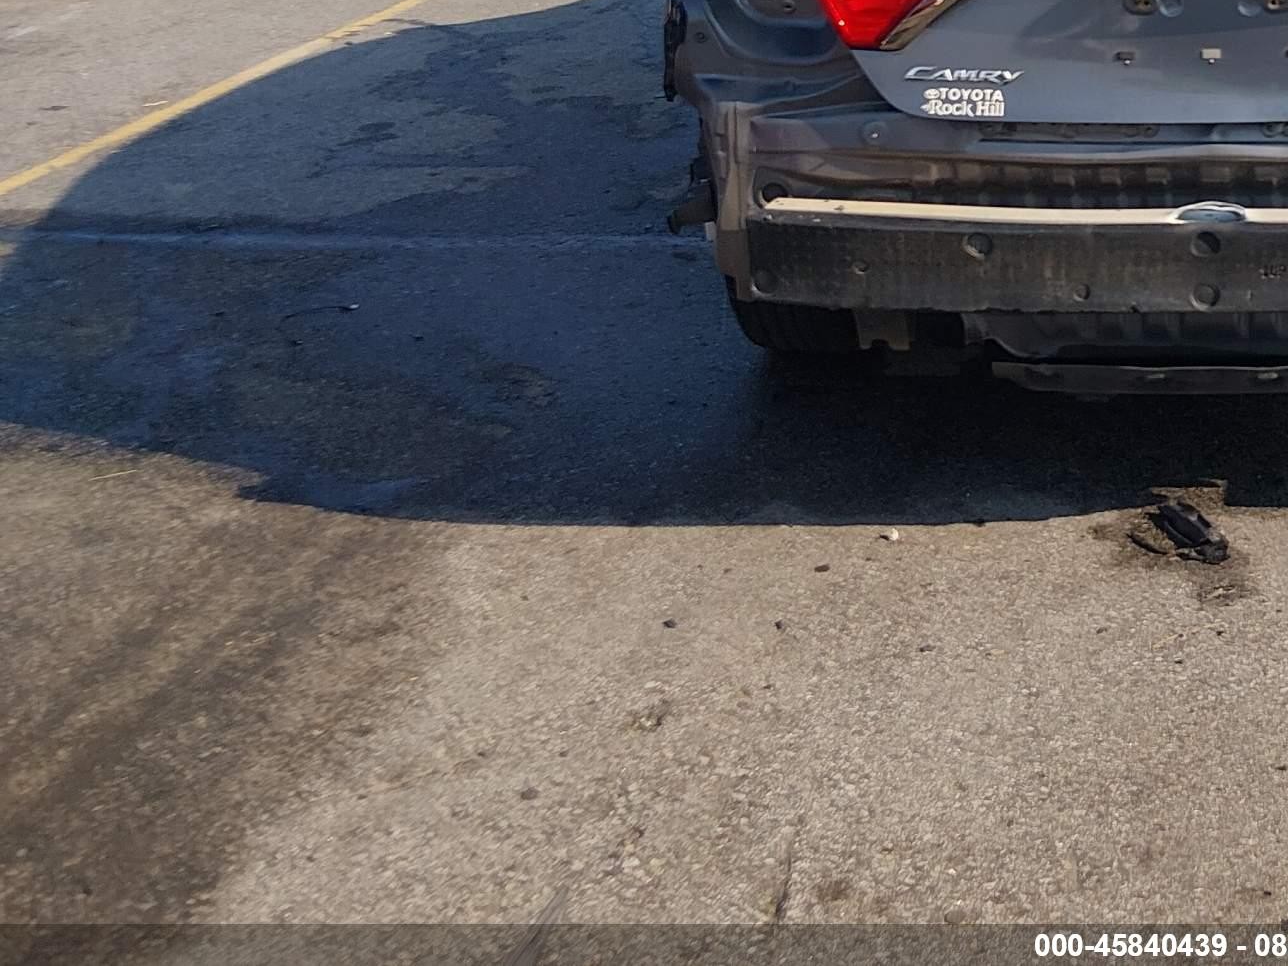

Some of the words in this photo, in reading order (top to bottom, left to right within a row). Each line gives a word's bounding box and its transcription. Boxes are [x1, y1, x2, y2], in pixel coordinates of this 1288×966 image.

[904, 66, 1024, 85] CAMRY
[940, 87, 1004, 101] TOYOTA
[927, 99, 975, 117] Rock
[976, 101, 1005, 116] Hill
